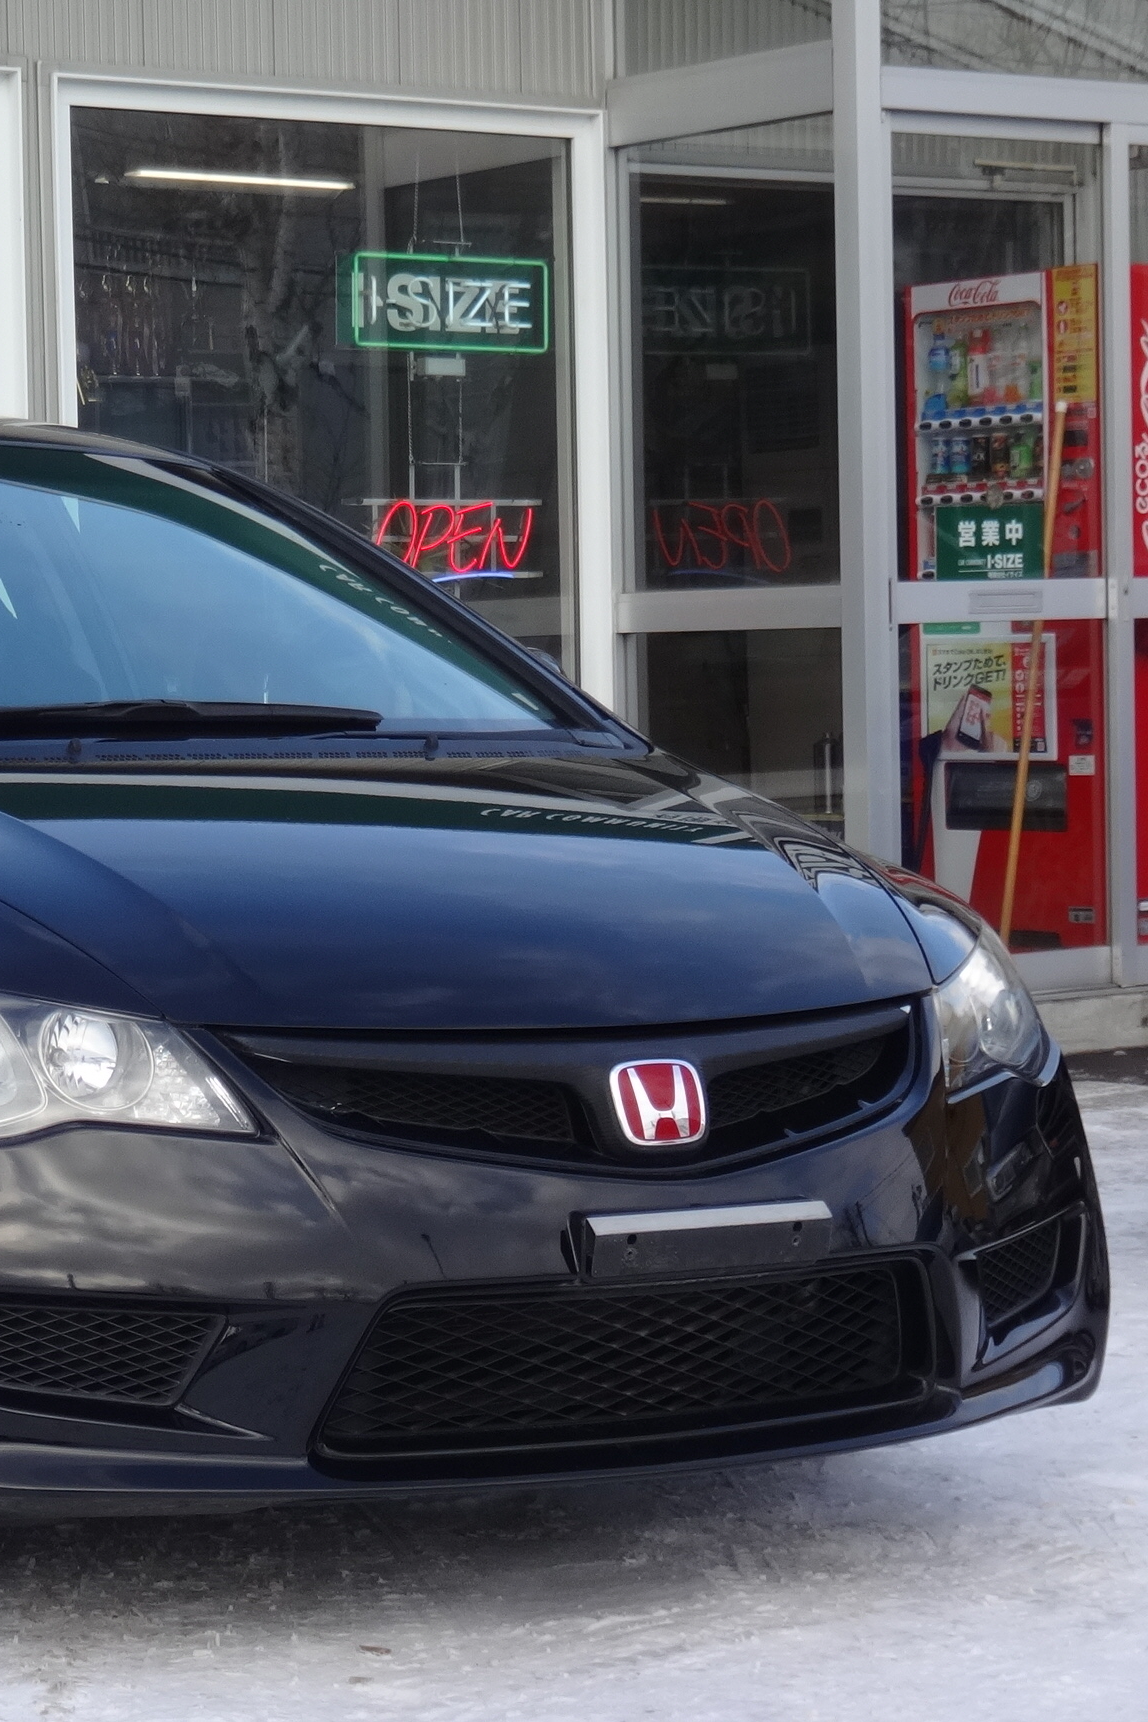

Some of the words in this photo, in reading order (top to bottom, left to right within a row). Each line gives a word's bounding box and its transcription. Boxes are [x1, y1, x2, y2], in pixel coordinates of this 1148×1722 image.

[948, 280, 1001, 307] Coca-Cola
[376, 500, 533, 573] OPEN
[957, 519, 1023, 547] 営業中
